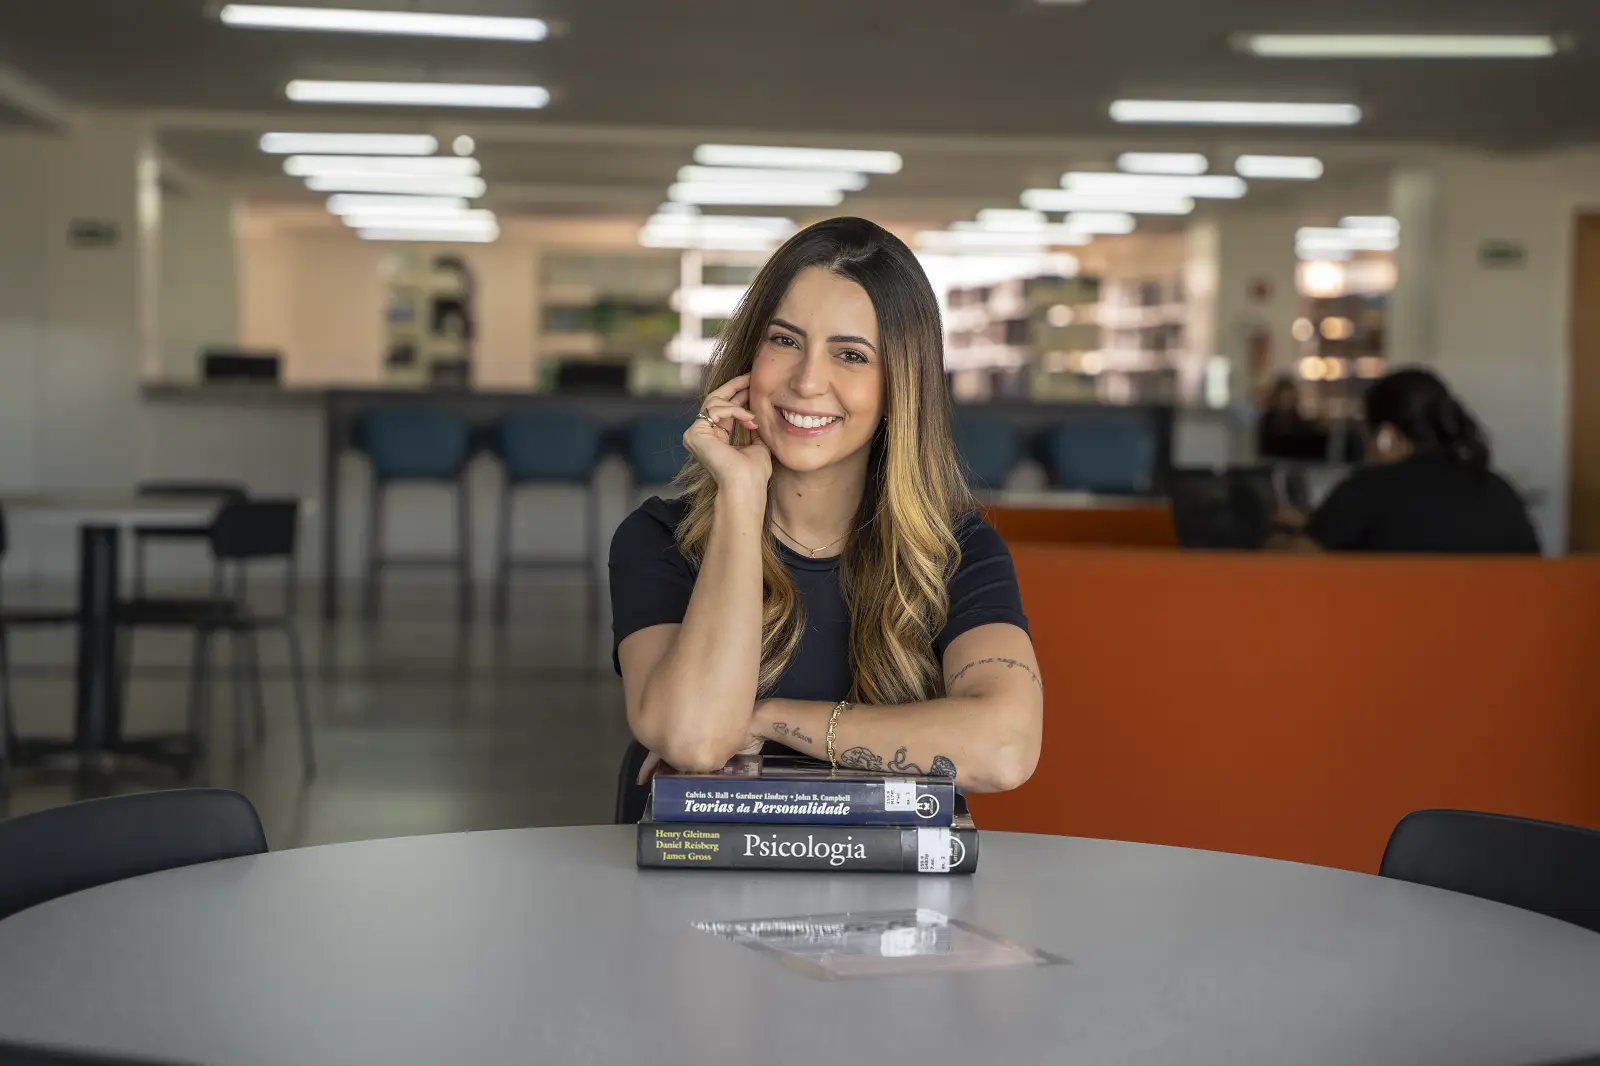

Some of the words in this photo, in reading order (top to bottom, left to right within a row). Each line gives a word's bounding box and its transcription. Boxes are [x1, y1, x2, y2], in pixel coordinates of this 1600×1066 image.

[735, 792, 763, 800] Gardner
[764, 793, 788, 801] Lindzey
[794, 793, 811, 801] John
[820, 794, 851, 803] Campbell
[684, 800, 734, 813] Teorias
[736, 804, 751, 813] da
[752, 801, 850, 816] Personalidade
[655, 829, 681, 840] Henry
[682, 831, 720, 839] Gleitman
[656, 840, 683, 849] Daniel
[684, 841, 719, 852] Reisberg
[742, 834, 867, 866] Psicologia
[662, 851, 686, 861] James
[688, 853, 712, 861] Gross
